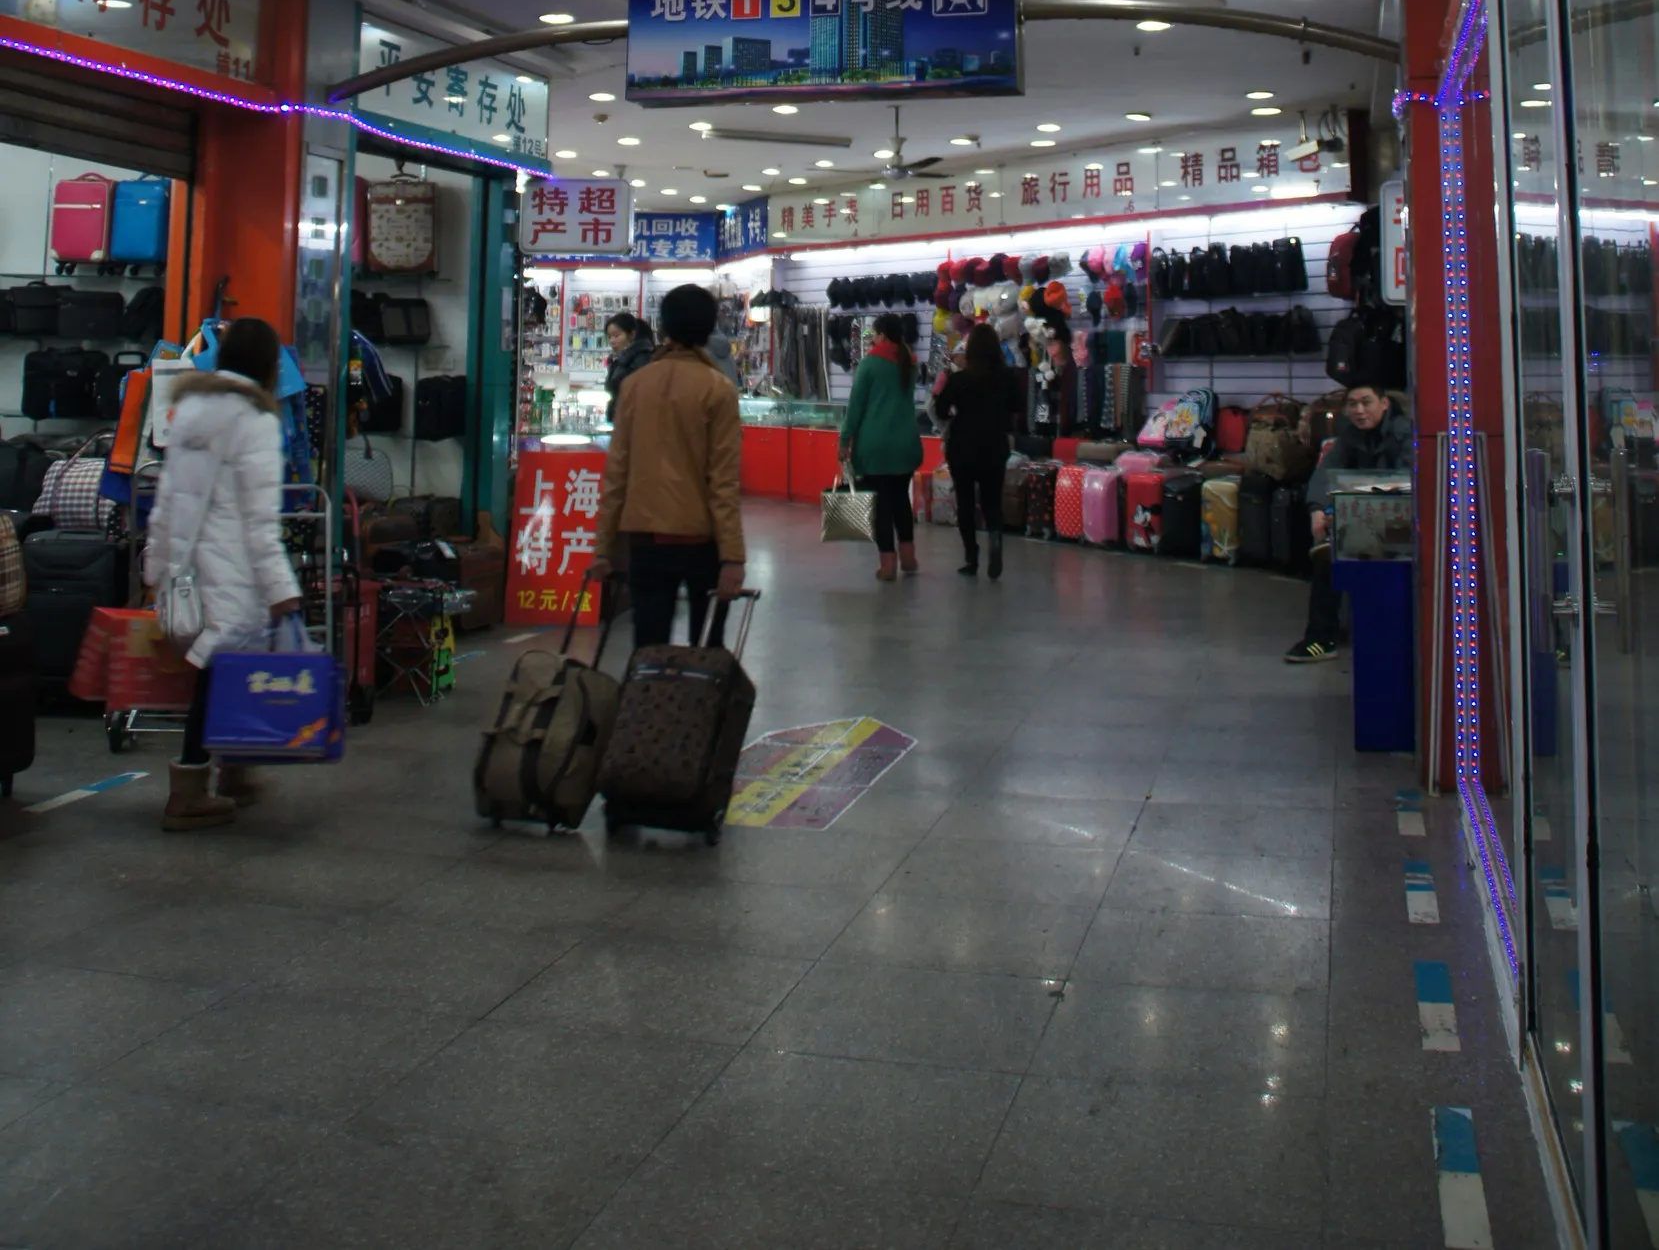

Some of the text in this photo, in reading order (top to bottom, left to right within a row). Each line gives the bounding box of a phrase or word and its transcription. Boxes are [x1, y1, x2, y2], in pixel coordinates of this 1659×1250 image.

[377, 38, 526, 134] 平安寄存处
[891, 183, 984, 221] 日用百货
[1020, 161, 1135, 206] 旅行用品
[781, 197, 859, 232] 精美手表
[518, 468, 602, 519] 上海
[515, 526, 598, 577] 特产
